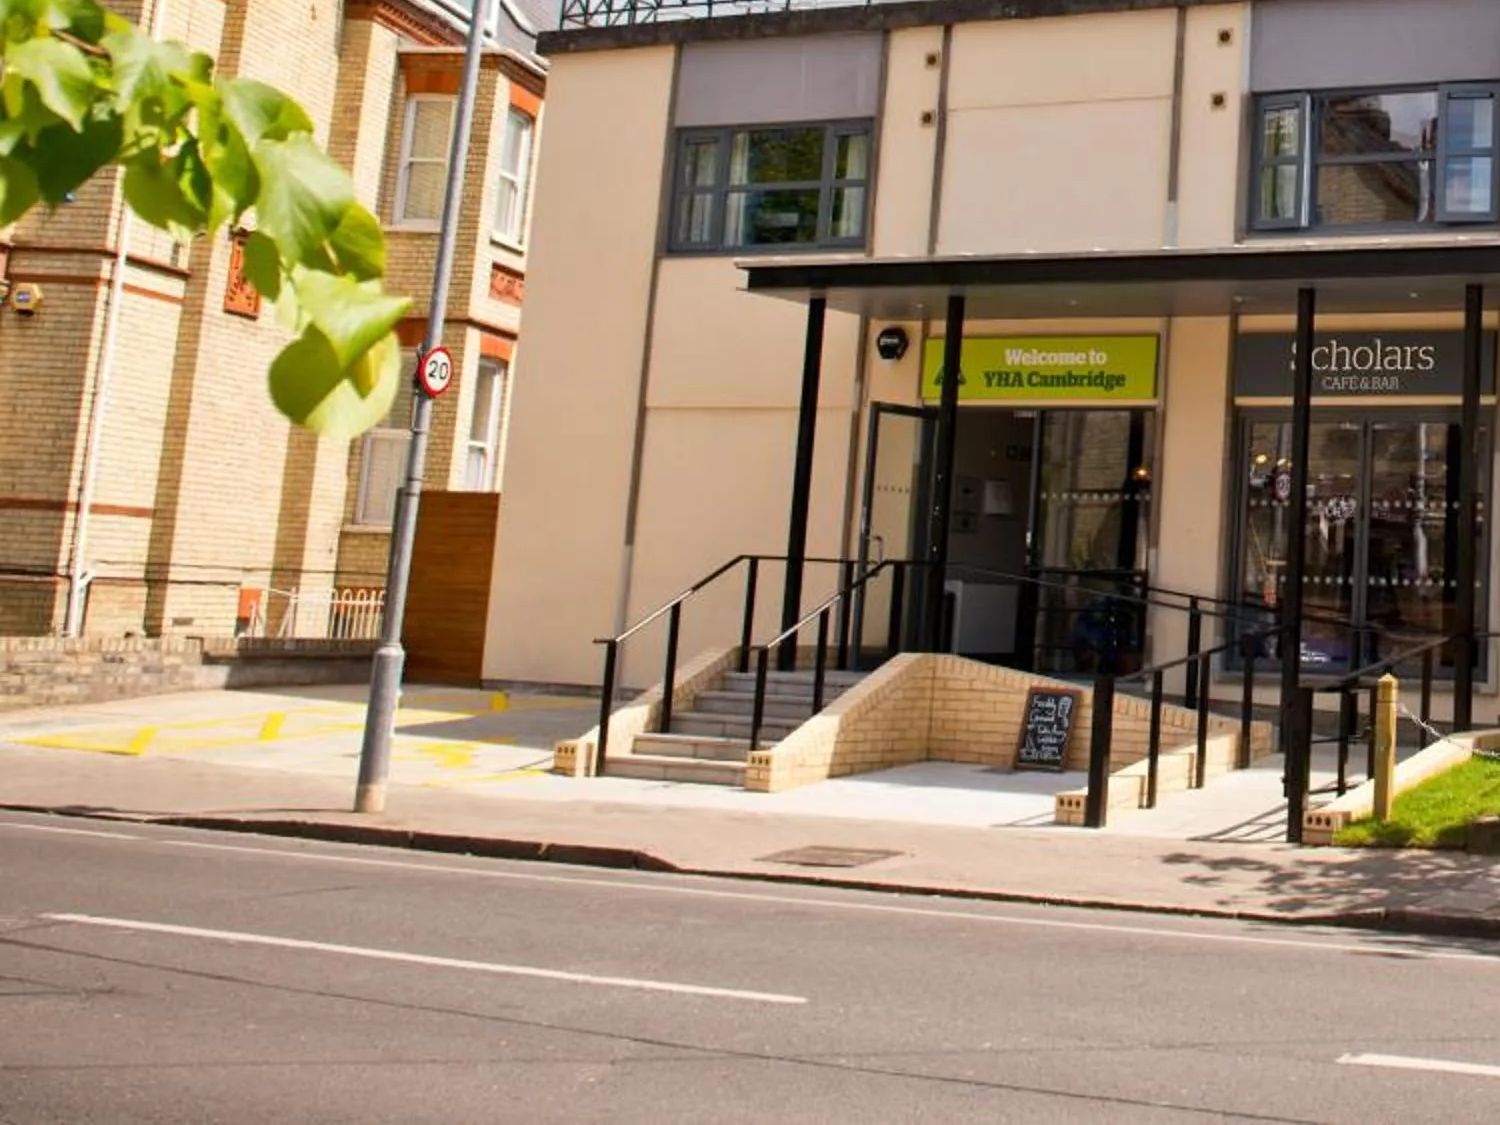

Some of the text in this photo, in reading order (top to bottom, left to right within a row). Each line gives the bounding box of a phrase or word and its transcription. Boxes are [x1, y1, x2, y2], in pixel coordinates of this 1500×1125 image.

[1004, 348, 1108, 366] Welcome to
[428, 360, 449, 380] 20
[983, 370, 1126, 392] YHA Cambridge
[1371, 376, 1400, 391] BAR
